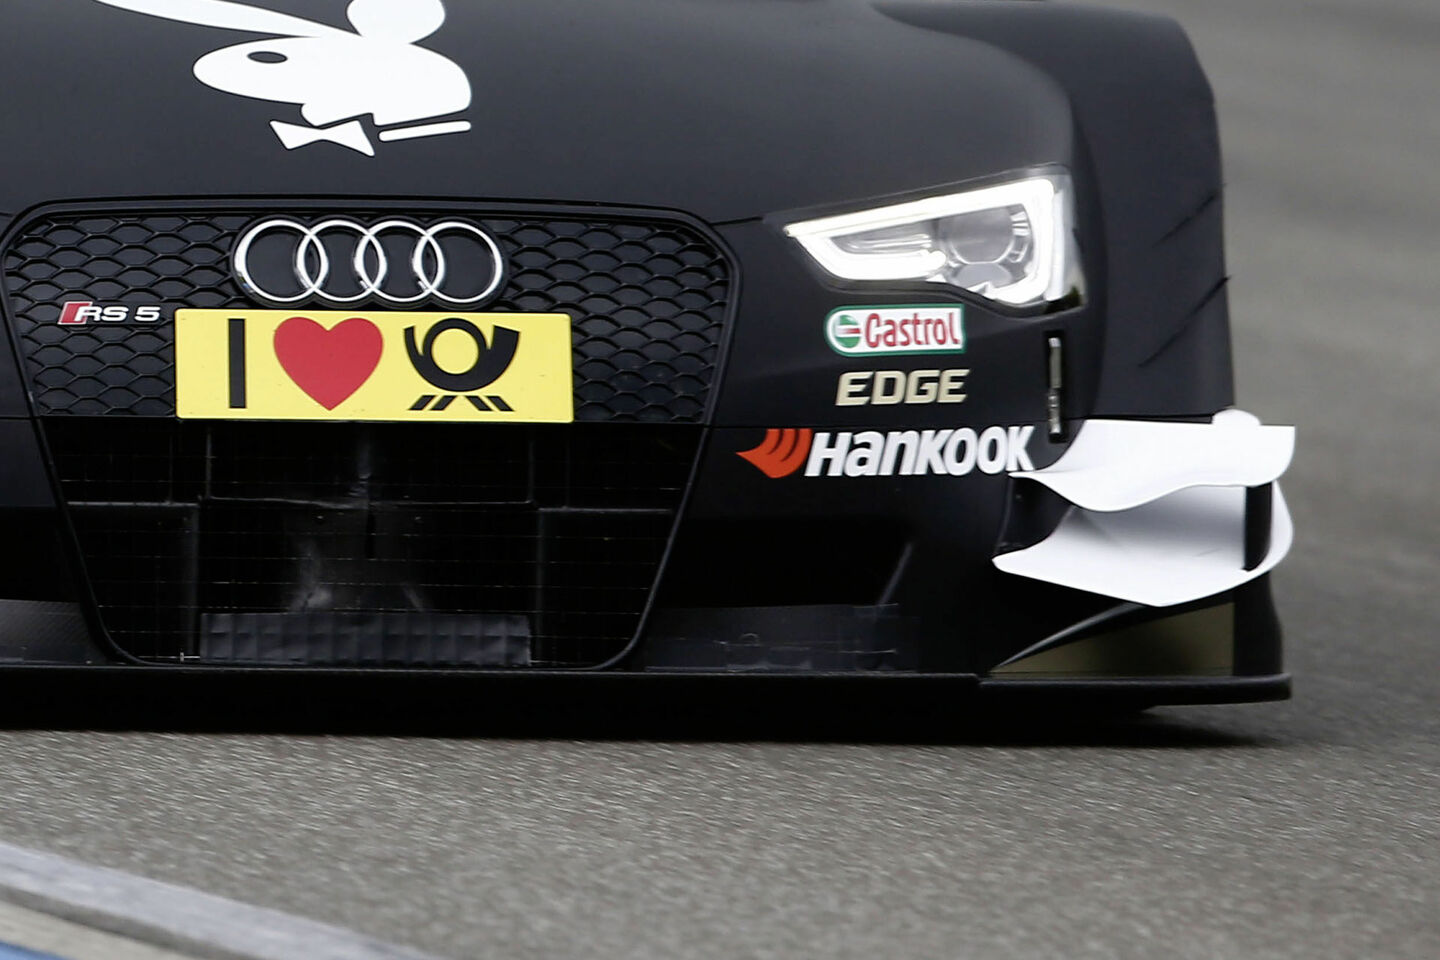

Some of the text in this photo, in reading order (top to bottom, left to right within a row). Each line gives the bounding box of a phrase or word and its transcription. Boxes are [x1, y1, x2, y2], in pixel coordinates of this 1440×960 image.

[134, 305, 161, 322] 5
[864, 312, 959, 348] Castrol
[227, 318, 247, 409] I
[835, 368, 970, 406] EDGE
